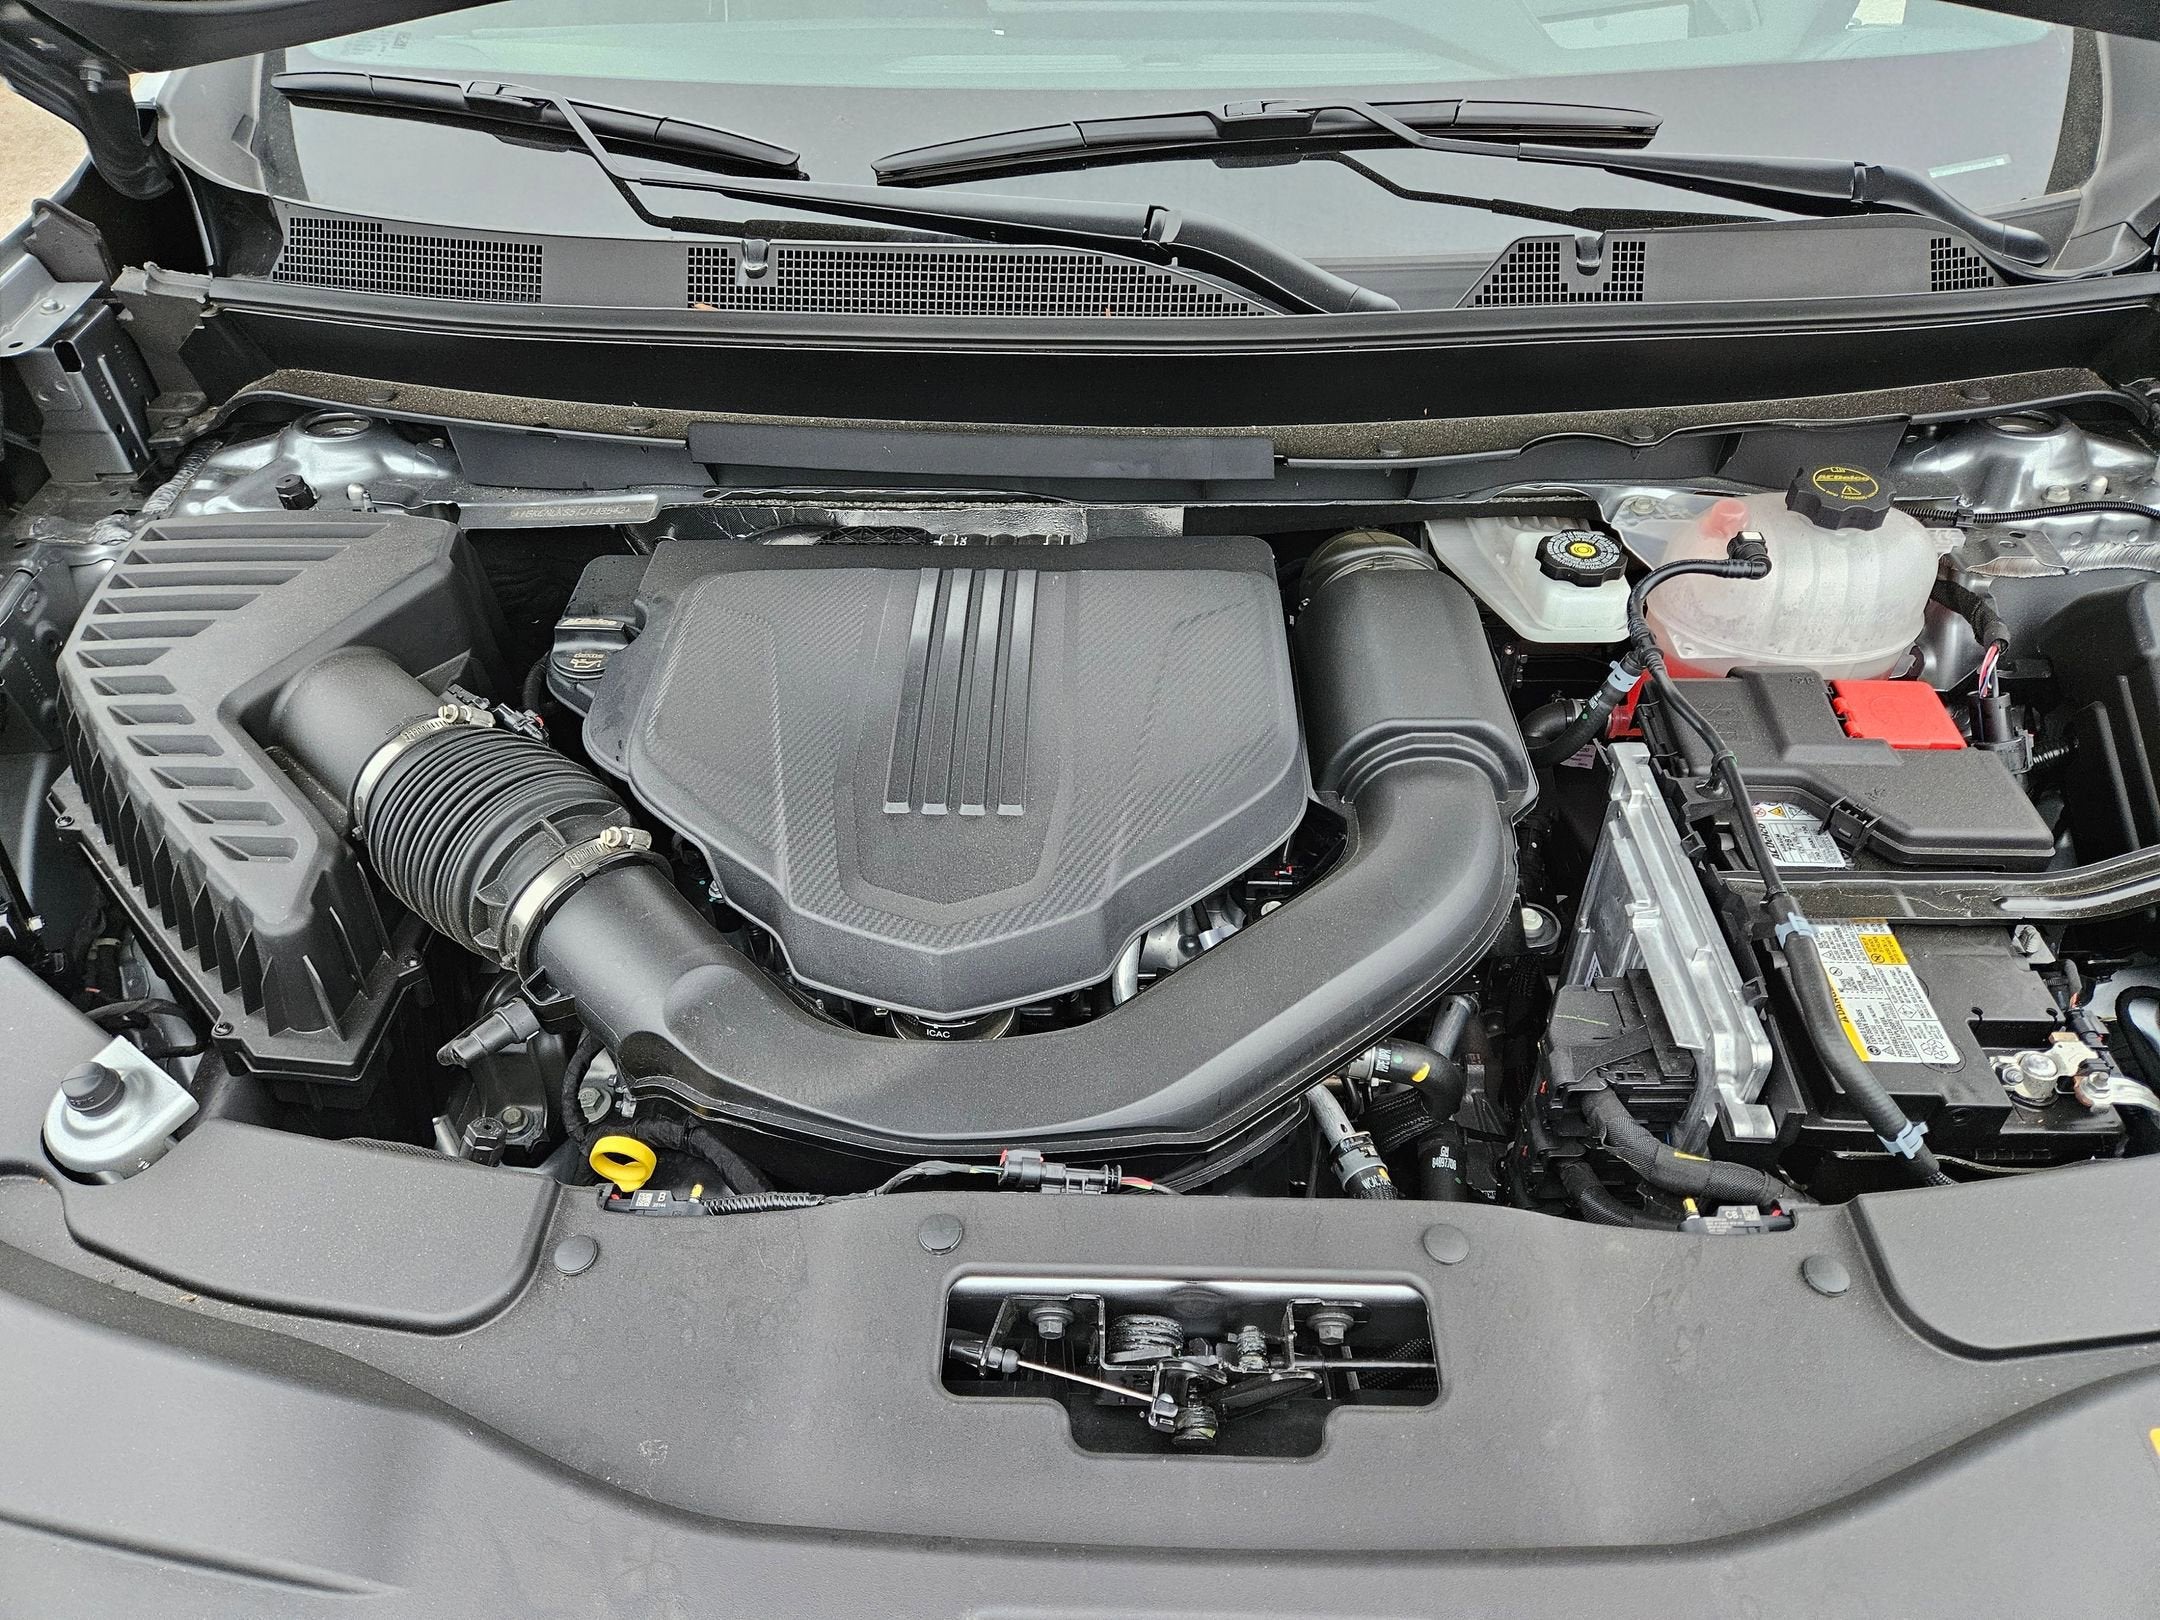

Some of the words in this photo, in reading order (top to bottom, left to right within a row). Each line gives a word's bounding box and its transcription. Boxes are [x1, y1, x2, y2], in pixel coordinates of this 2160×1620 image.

[1758, 822, 1782, 861] ACDelco
[926, 1028, 951, 1039] ICAC
[658, 1192, 666, 1202] B
